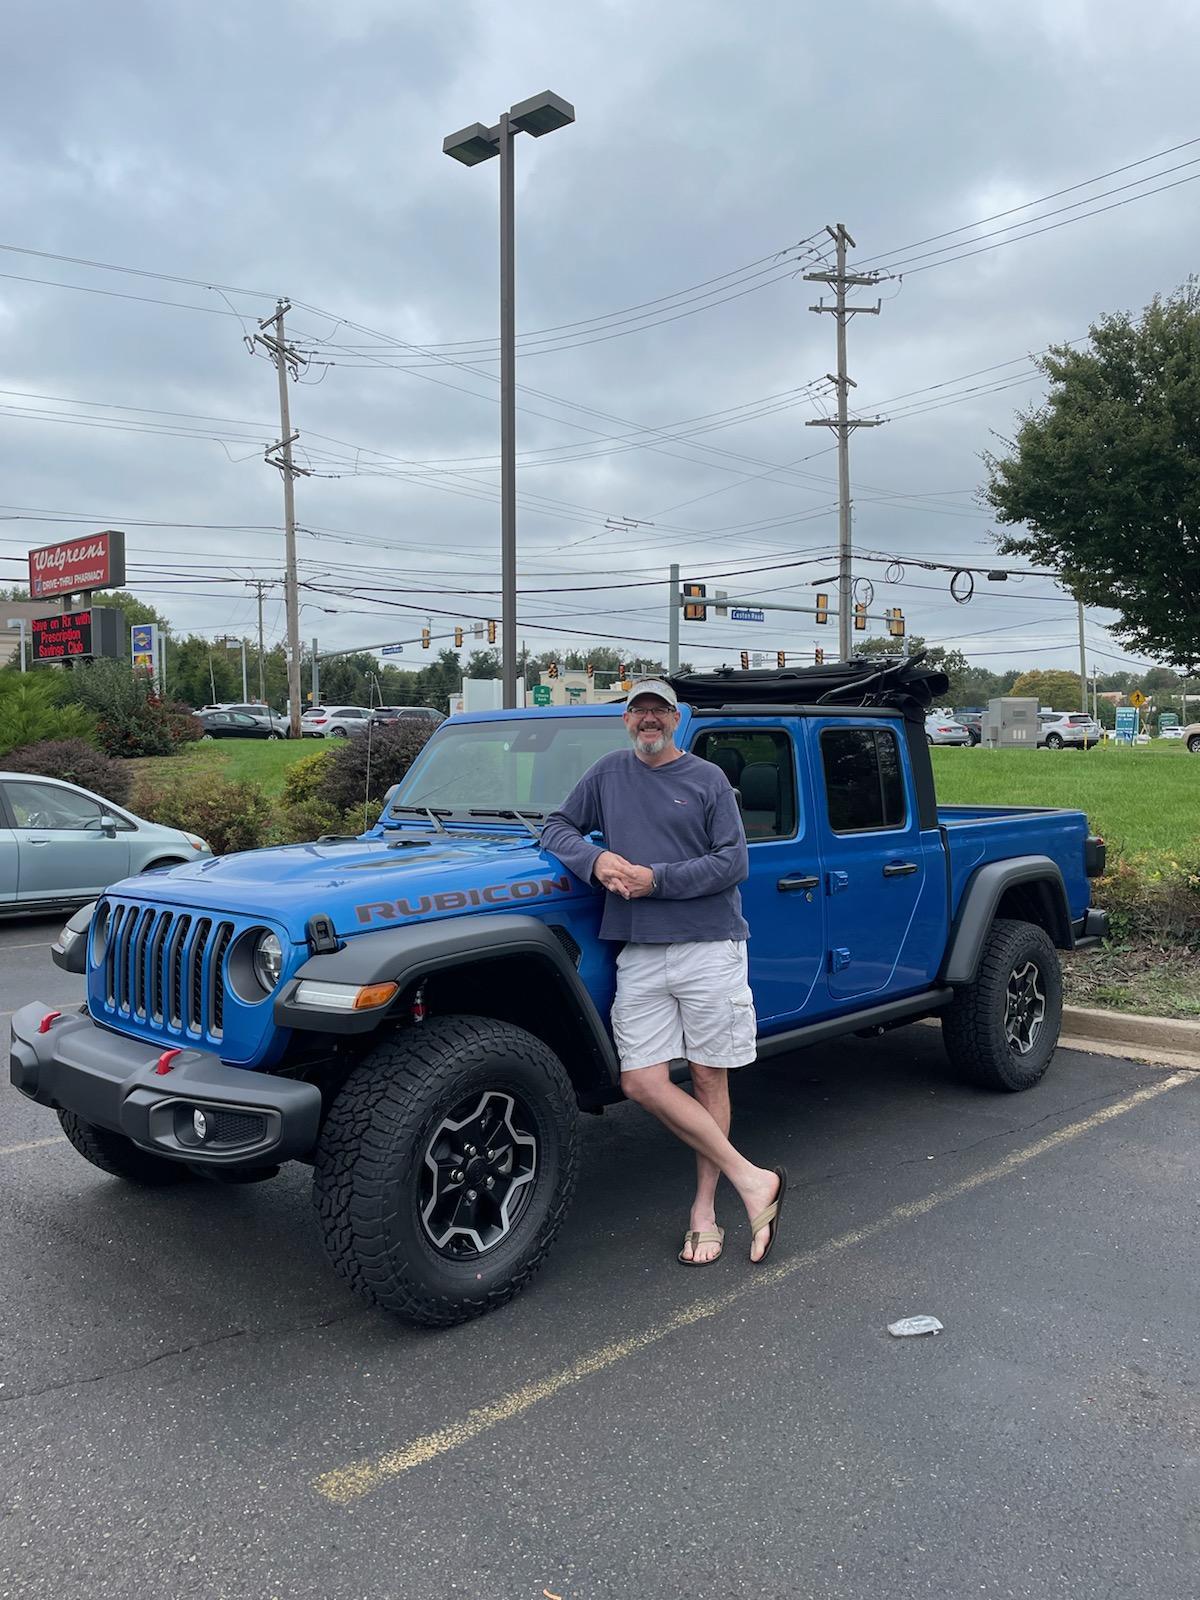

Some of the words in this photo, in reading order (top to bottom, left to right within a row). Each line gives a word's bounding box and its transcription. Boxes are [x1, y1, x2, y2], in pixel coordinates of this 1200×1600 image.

[33, 541, 106, 571] Walgreens
[42, 575, 74, 591] DRIVE-THRU
[74, 569, 105, 584] PHARMACY
[32, 620, 47, 632] Save
[50, 619, 59, 629] on
[62, 614, 72, 628] Rx
[75, 612, 91, 625] with
[41, 629, 80, 643] Prescription
[39, 643, 64, 657] Savings
[68, 641, 84, 654] Club
[356, 876, 570, 924] RUBICON
